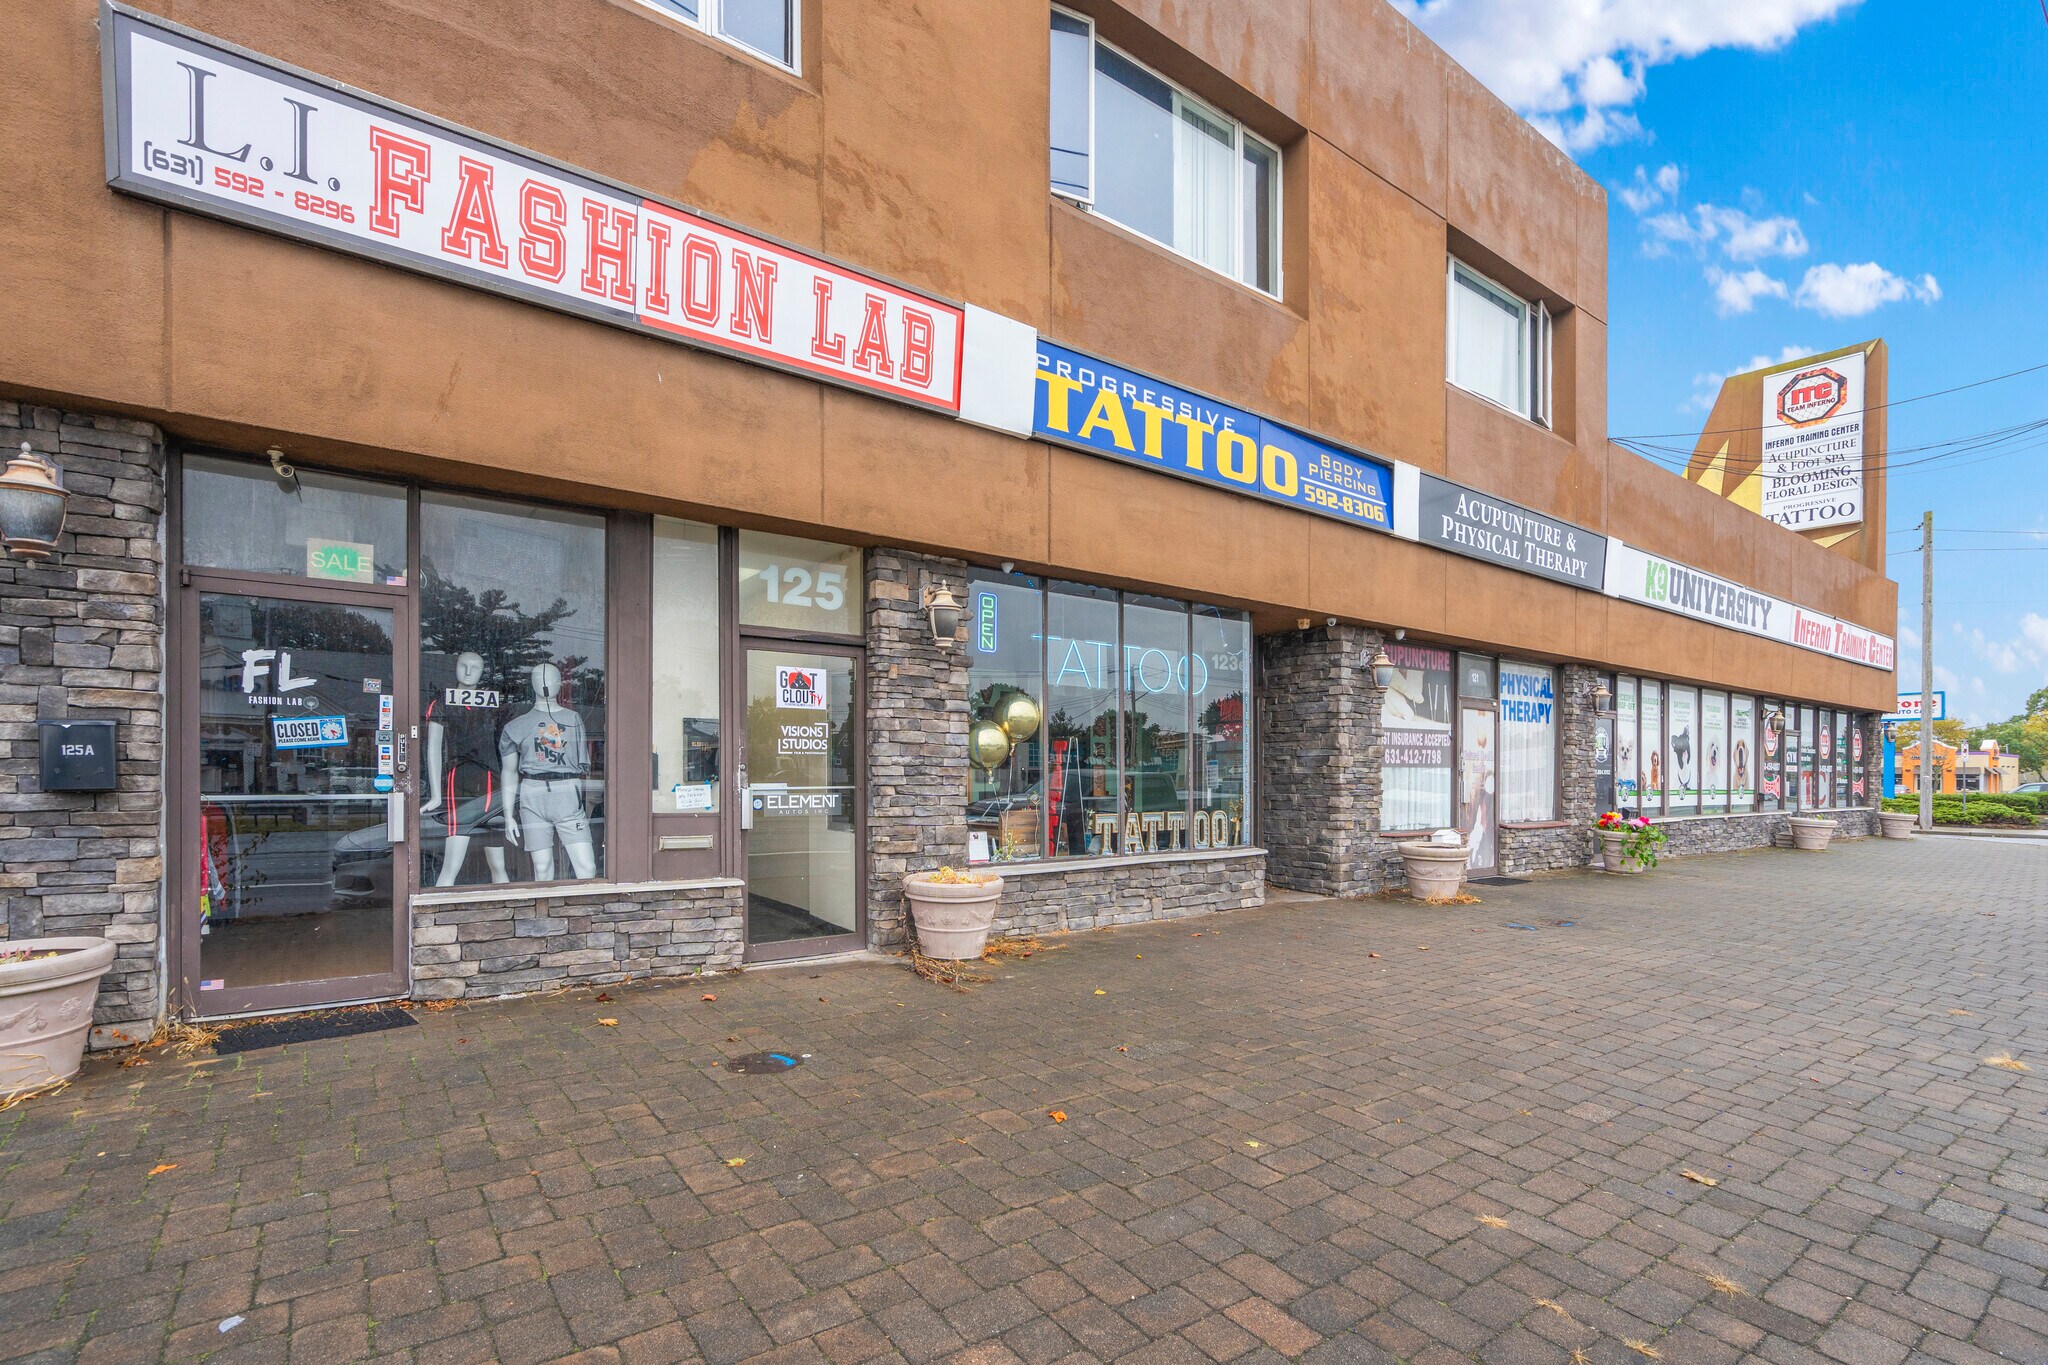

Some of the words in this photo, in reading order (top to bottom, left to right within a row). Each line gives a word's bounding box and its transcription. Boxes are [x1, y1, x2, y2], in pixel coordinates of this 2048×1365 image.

[143, 140, 204, 185] (631)
[213, 167, 264, 198] 592
[294, 192, 356, 224] 8296
[177, 61, 341, 192] L.I.
[369, 125, 777, 345] FASHION
[811, 275, 935, 390] LAB
[1036, 353, 1236, 434] PROGRESSIVE
[1786, 404, 1806, 414] TEAM
[1806, 397, 1836, 410] INFERNO
[1791, 382, 1833, 405] ITC
[1036, 368, 1298, 498] TATTOO
[1765, 436, 1795, 450] INFERNO
[1796, 429, 1830, 444] TRAINING
[1831, 423, 1860, 437] CENTER
[1768, 437, 1857, 464] ACUPUNCTURE
[1776, 463, 1787, 474] &
[1791, 457, 1821, 472] FOOT
[1824, 452, 1845, 467] SPA
[1320, 453, 1364, 480] BODY
[1772, 465, 1851, 489] BLOOMING
[1308, 462, 1377, 497] PIERCING
[1765, 485, 1811, 501] FLORAL
[1813, 476, 1859, 493] DESIGN
[1304, 484, 1385, 523] 592-8306
[1765, 502, 1856, 527] TATTOO
[1783, 497, 1837, 511] PROGRESSIVE
[1455, 493, 1562, 547] ACUPUNTURE
[1566, 532, 1577, 553] &
[1441, 515, 1521, 560] PHYSICAL
[1524, 541, 1588, 579] THERAPY
[310, 551, 372, 573] SALE
[759, 563, 844, 611] 125
[981, 596, 995, 650] OPEN
[1794, 609, 1832, 651] INFERNO
[1834, 623, 1867, 660] TRAINING
[1868, 635, 1893, 668] CENTER
[1384, 643, 1451, 672] CUPUNCTURE
[242, 649, 317, 693] FL
[448, 689, 498, 706] 125A
[782, 689, 816, 704] CLOUT
[1500, 672, 1554, 699] PHYSICAL
[248, 696, 282, 706] FASHION
[287, 697, 303, 706] LAB
[1501, 700, 1553, 724] THERAPY
[276, 722, 319, 739] CLOSED
[781, 725, 823, 738] VISIONS
[1391, 731, 1423, 746] INSURANCE
[1424, 733, 1451, 747] ACCEPTED
[61, 744, 95, 756] 125A
[782, 738, 828, 750] STUDIOS
[1384, 748, 1442, 765] 631-412-7798
[767, 794, 839, 809] ELEMENT
[1095, 811, 1229, 855] TATTOO
